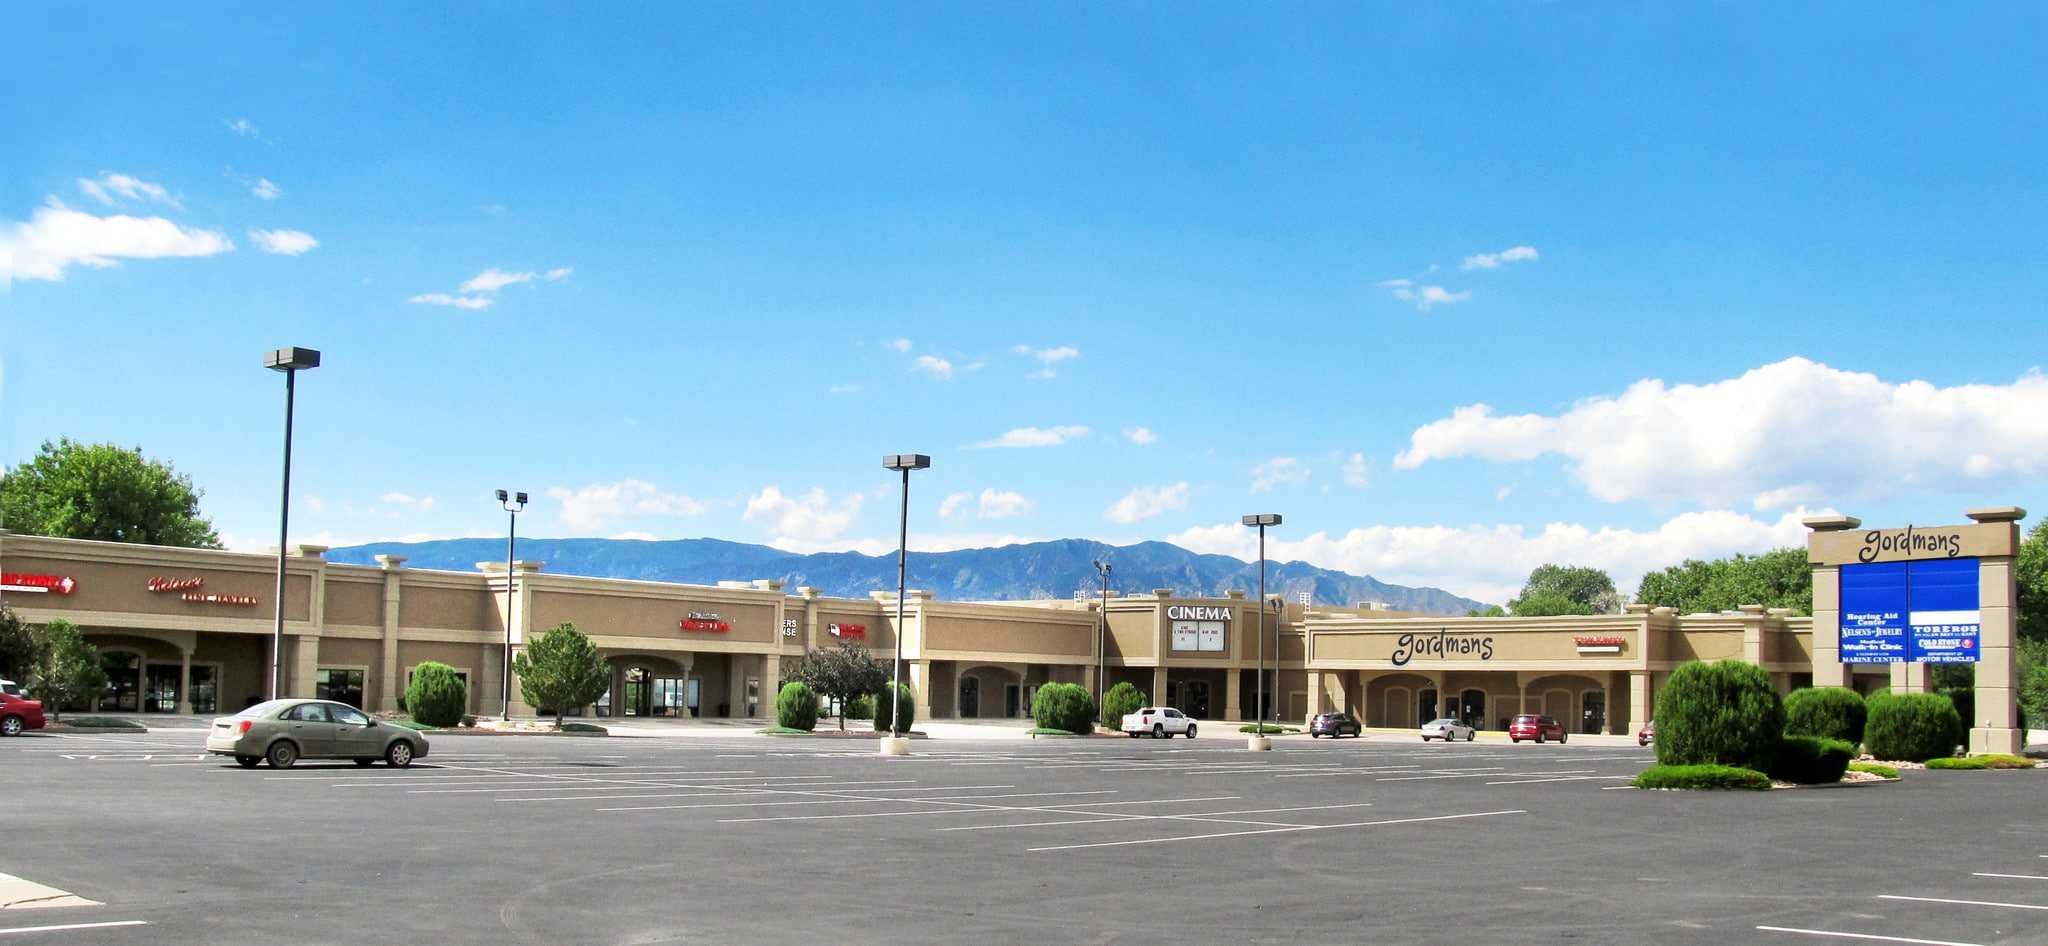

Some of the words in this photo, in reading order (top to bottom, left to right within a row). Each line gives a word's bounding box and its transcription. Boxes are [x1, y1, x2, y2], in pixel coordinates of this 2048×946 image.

[1858, 524, 1961, 563] gordmans
[1167, 605, 1232, 621] CINEMA
[1847, 613, 1882, 621] Hearing
[1883, 612, 1899, 620] Aid
[1875, 626, 1903, 637] JEWELRY
[1913, 625, 1979, 633] TOREROS
[1391, 627, 1494, 666] gordmans
[1918, 638, 1938, 648] COLD
[1938, 638, 1961, 648] STONE
